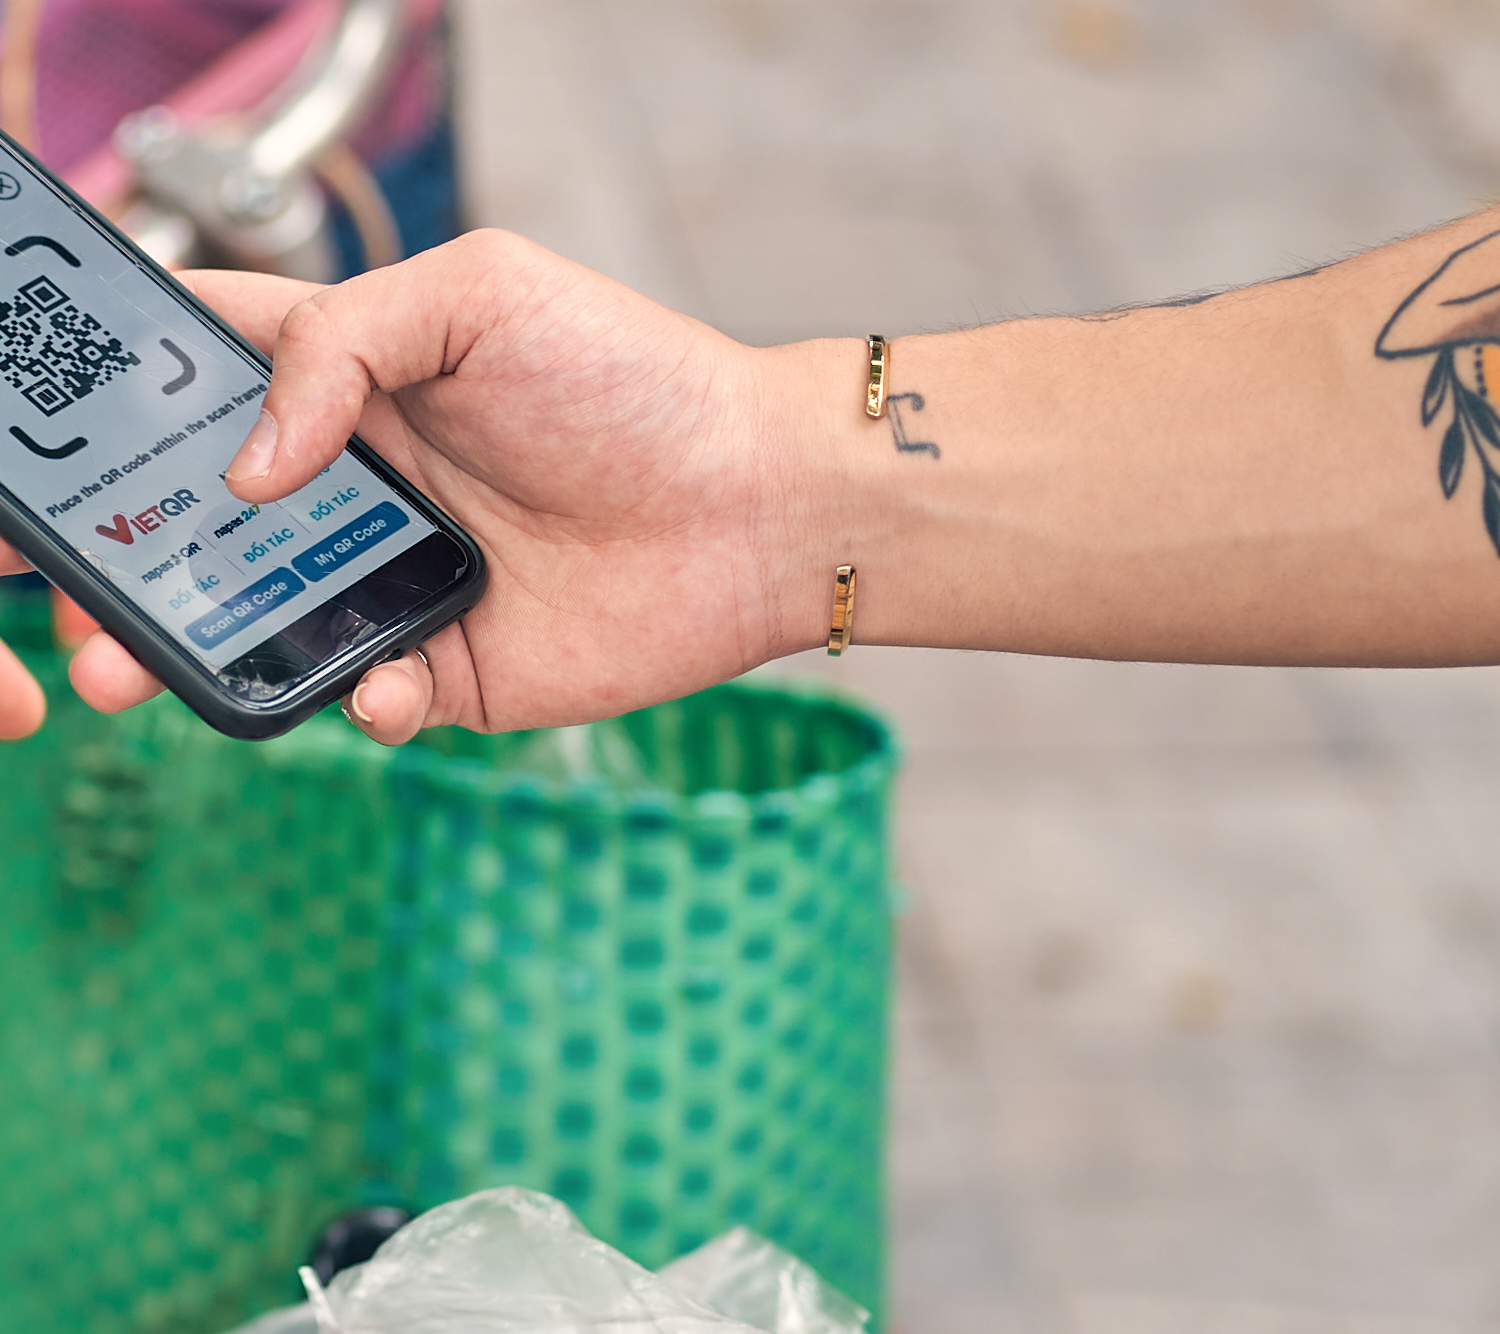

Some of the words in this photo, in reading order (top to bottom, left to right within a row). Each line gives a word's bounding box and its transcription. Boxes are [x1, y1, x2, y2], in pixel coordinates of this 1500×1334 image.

[45, 495, 83, 518] Place
[80, 482, 103, 498] the
[100, 468, 124, 485] QR
[122, 454, 152, 474] code
[149, 430, 188, 456] within
[184, 417, 207, 436] the
[206, 401, 235, 423] scan
[95, 489, 201, 545] VIETQR
[213, 516, 244, 538] napas
[240, 503, 261, 521] 247
[309, 500, 336, 521] ĐỐI
[331, 487, 360, 508] TÁC
[242, 541, 270, 563] ĐỐI
[265, 528, 294, 548] TÁC
[313, 548, 337, 567] My
[333, 537, 355, 554] QR
[352, 518, 387, 542] Code
[141, 559, 174, 585] napas
[191, 574, 220, 594] TÁC
[201, 614, 235, 638] Scan
[232, 601, 254, 618] QR
[252, 581, 288, 605] Code
